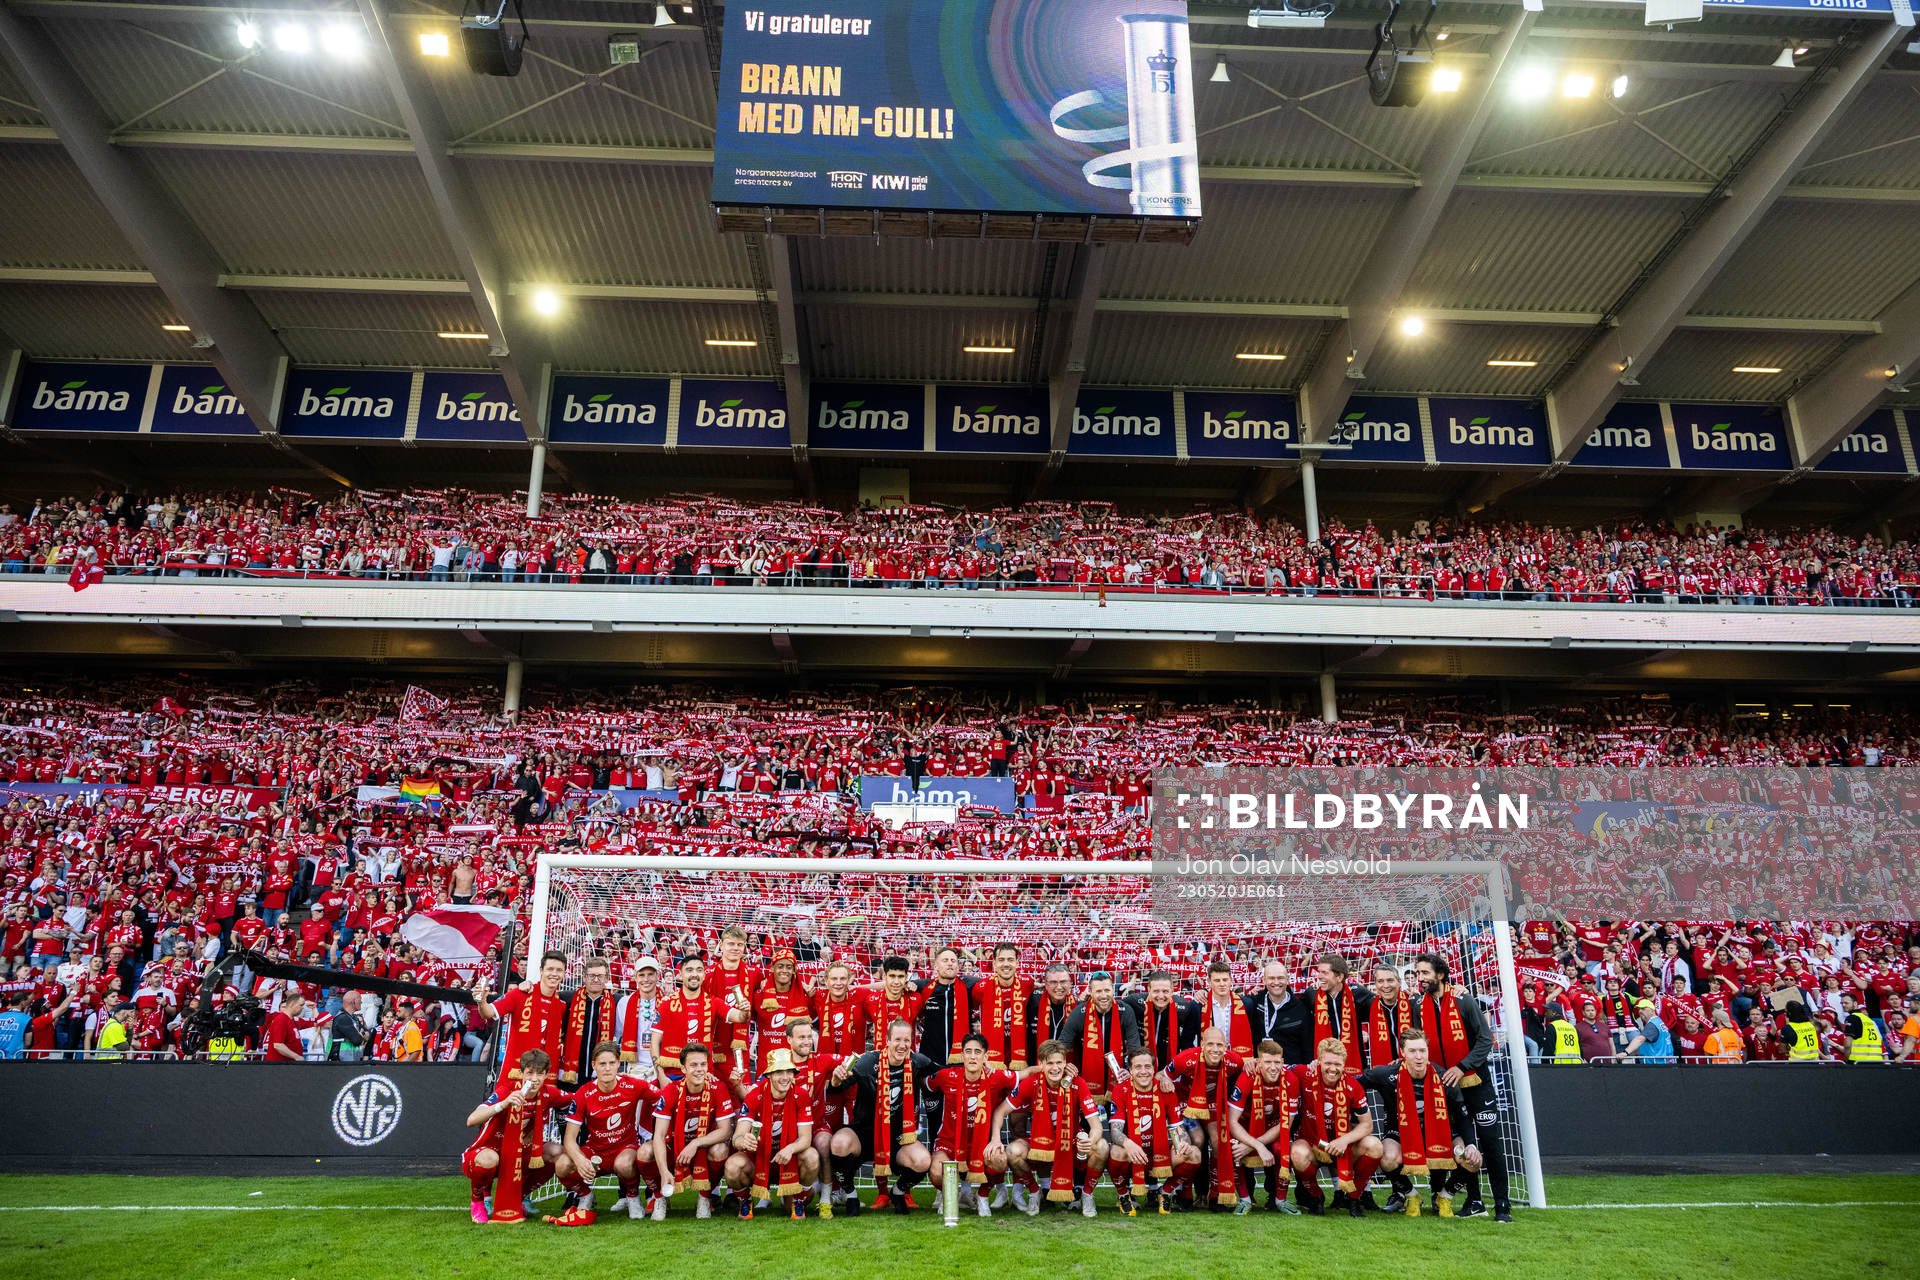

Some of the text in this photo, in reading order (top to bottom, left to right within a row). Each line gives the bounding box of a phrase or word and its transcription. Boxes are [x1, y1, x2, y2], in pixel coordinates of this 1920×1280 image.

[745, 11, 872, 36] Vi gratulerer
[740, 63, 842, 96] BRANN
[737, 102, 954, 140] MED NM-GULL!
[831, 173, 863, 182] THON
[872, 175, 910, 191] KIWI
[911, 176, 928, 184] mini
[911, 183, 926, 191] pris
[1146, 197, 1193, 205] KONGENS
[32, 381, 130, 412] bama
[171, 386, 245, 415] bam
[298, 387, 393, 418] bama
[563, 394, 657, 425] bama
[695, 400, 786, 429] bama
[818, 401, 910, 430] bama
[952, 406, 1040, 435] bama
[1071, 407, 1161, 436] bama
[1203, 411, 1290, 441] bama
[1328, 421, 1411, 442] ama
[1449, 418, 1535, 447] bama
[1586, 425, 1652, 448] ama
[1692, 423, 1776, 452] bama
[713, 558, 740, 566] BRANN
[153, 785, 253, 807] BERGEN
[892, 782, 971, 808] bama
[1317, 995, 1329, 1026] SK
[769, 1037, 782, 1045] Vest
[1563, 1033, 1575, 1047] 88
[1803, 1034, 1815, 1047] 15
[1867, 1028, 1877, 1041] 25
[1476, 1111, 1497, 1121] LERØY
